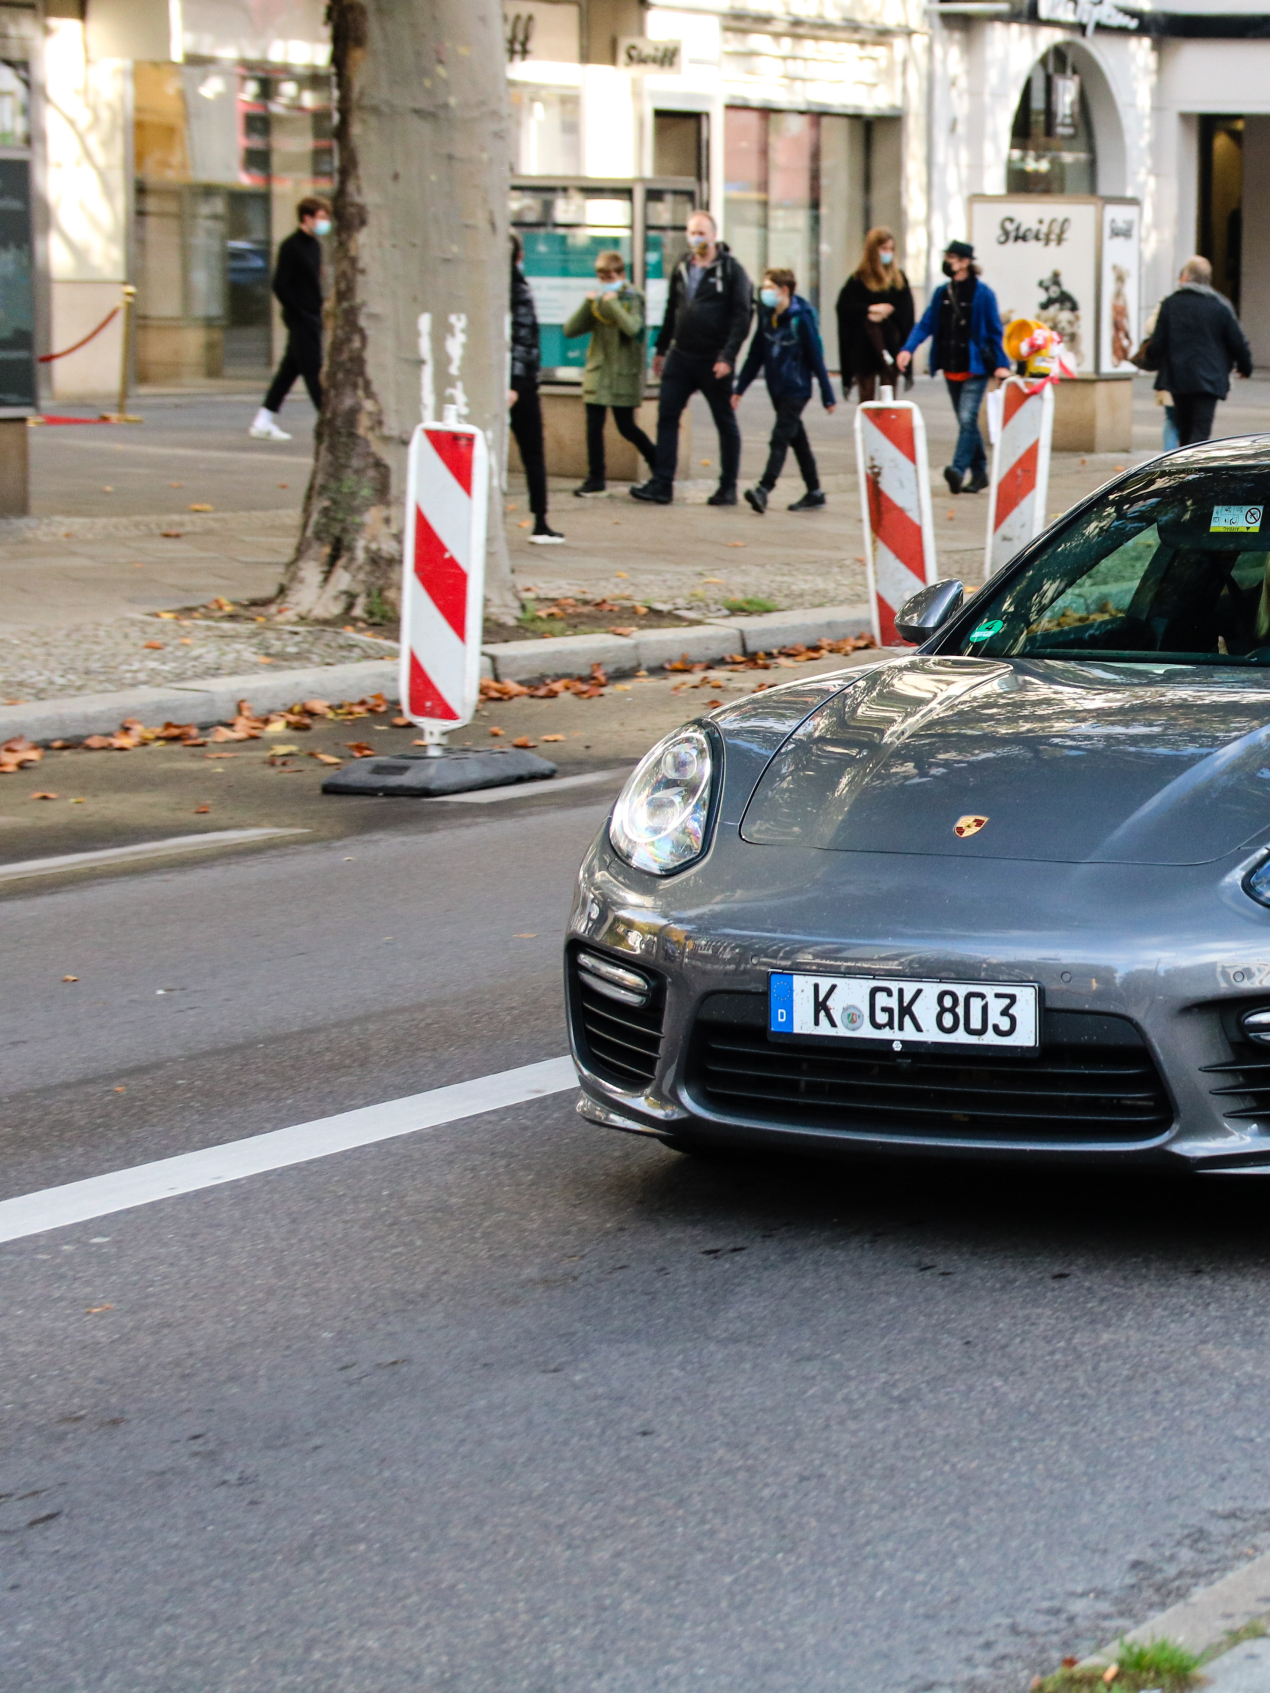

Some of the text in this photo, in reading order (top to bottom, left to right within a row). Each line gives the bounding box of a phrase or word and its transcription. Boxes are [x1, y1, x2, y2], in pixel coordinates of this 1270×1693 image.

[997, 216, 1070, 247] Steiff
[778, 1009, 787, 1022] D
[813, 982, 1017, 1037] K GK 803
